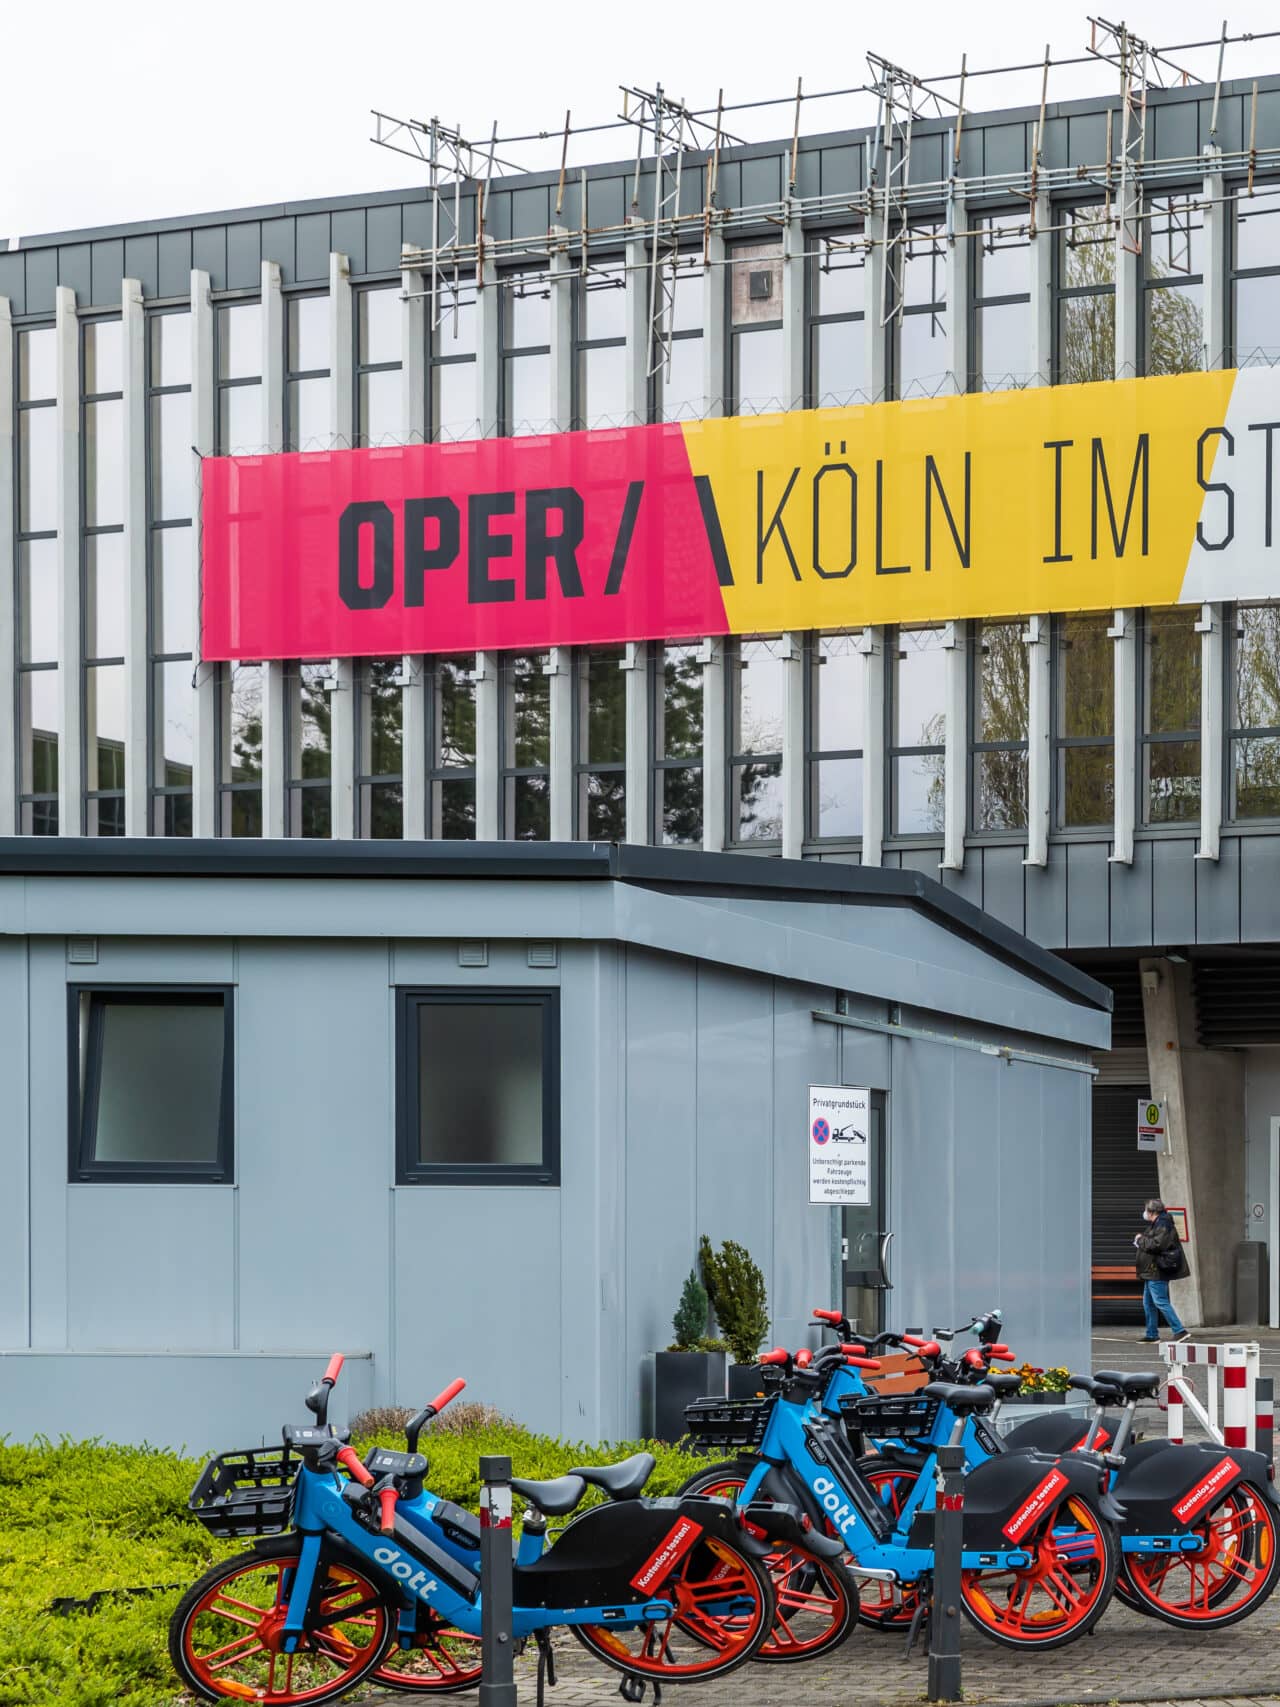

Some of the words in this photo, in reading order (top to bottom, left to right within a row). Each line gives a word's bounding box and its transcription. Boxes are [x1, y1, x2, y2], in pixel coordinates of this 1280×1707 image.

[1043, 433, 1150, 564] IM
[812, 1098, 866, 1110] Privatgrundstück
[813, 1477, 857, 1534] dott
[1007, 1499, 1039, 1536] Kostenlos
[1177, 1484, 1210, 1516] Kostenlos
[373, 1547, 439, 1599] dott
[637, 1551, 671, 1588] Kostenlos
